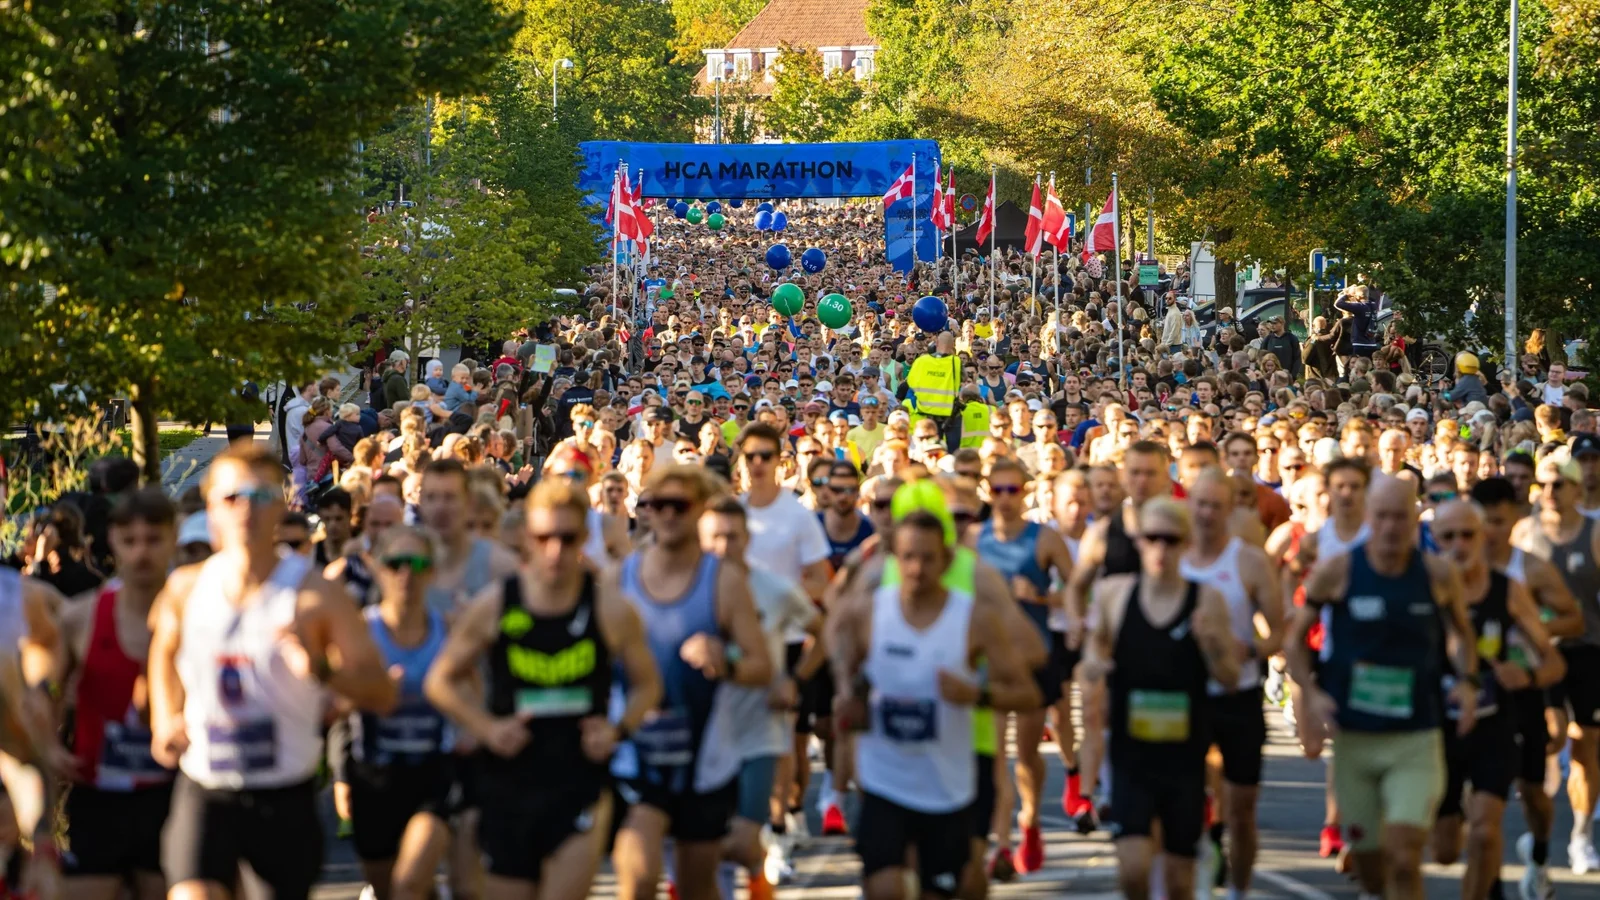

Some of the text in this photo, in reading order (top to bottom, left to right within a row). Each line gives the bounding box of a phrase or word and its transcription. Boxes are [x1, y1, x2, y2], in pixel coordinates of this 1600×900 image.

[665, 160, 852, 180] HCA MARATHON
[803, 259, 818, 272] 3.15
[825, 298, 844, 312] 1.30
